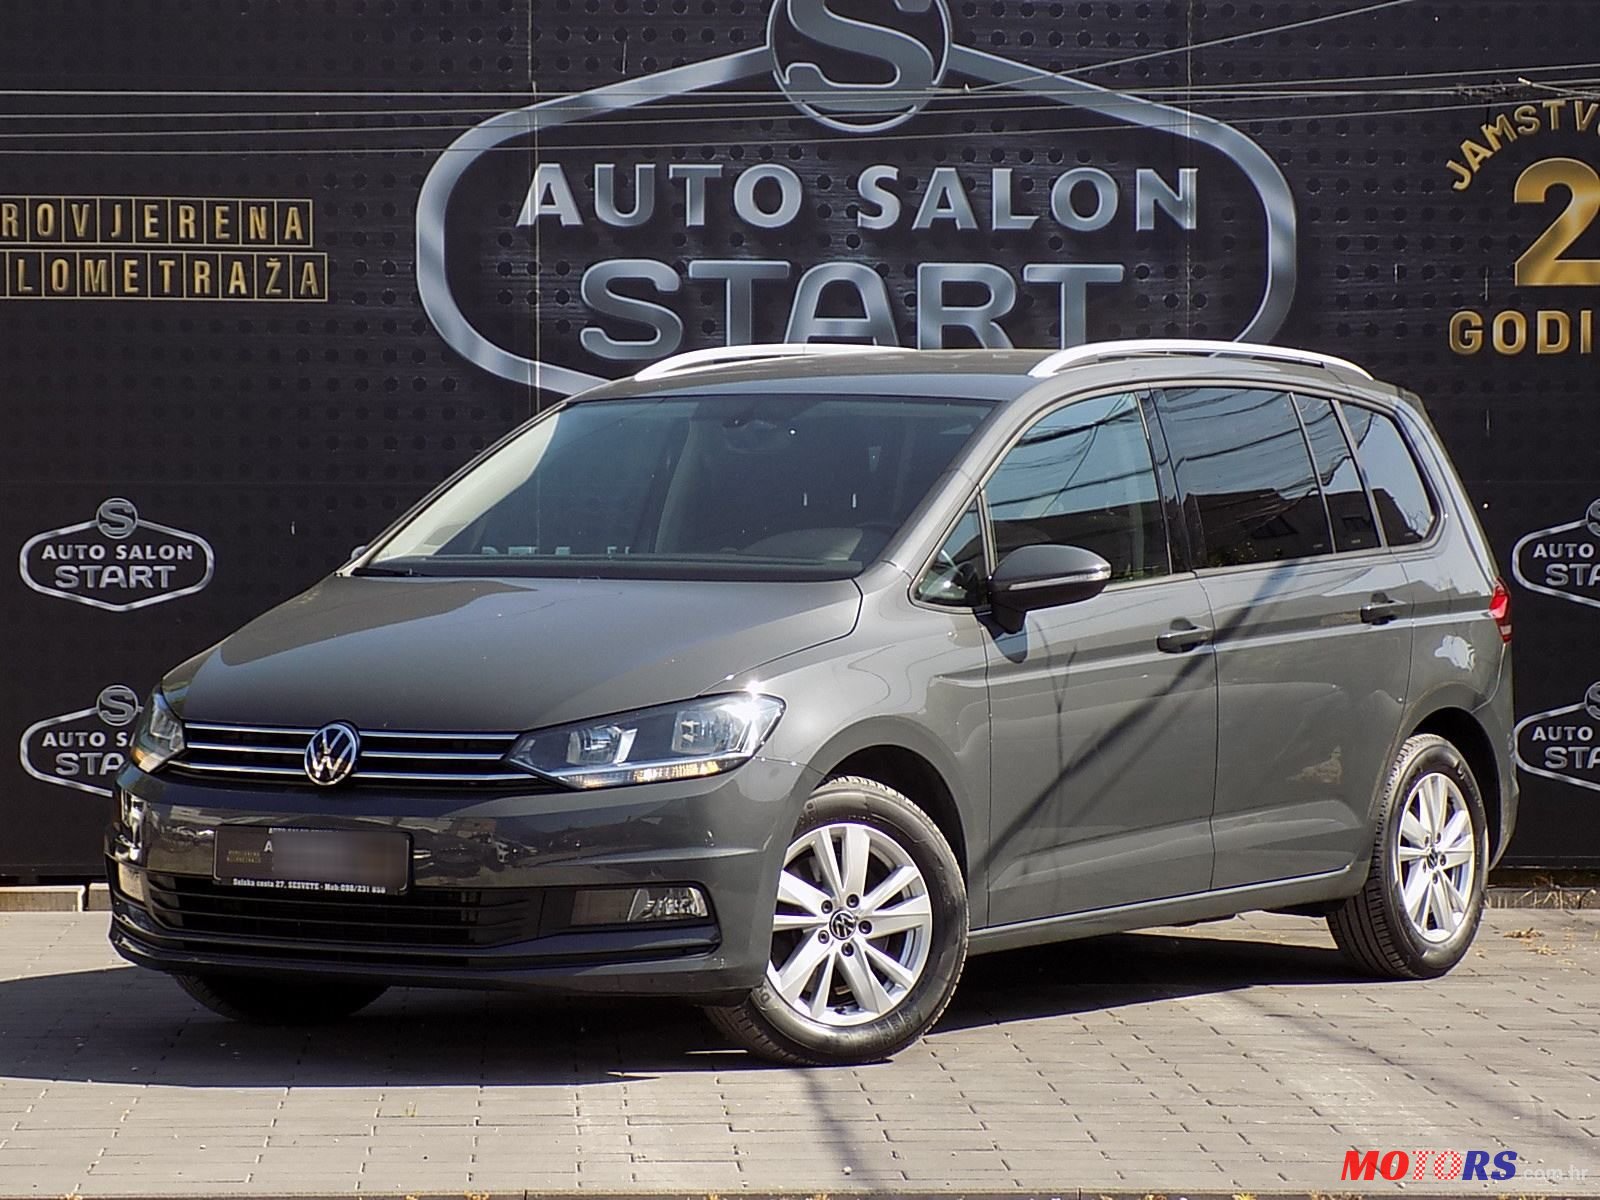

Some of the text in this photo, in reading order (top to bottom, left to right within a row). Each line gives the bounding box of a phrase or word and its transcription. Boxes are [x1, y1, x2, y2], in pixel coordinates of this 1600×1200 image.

[1446, 99, 1600, 191] JAMSTV
[516, 162, 1199, 232] AUTO SALON
[1513, 156, 1600, 287] 2
[579, 258, 1126, 361] START
[42, 544, 193, 561] AUTO SALON
[1533, 543, 1594, 559] AUTO
[55, 565, 176, 588] START
[42, 732, 106, 747] AUTO
[1531, 726, 1593, 741] AUTO
